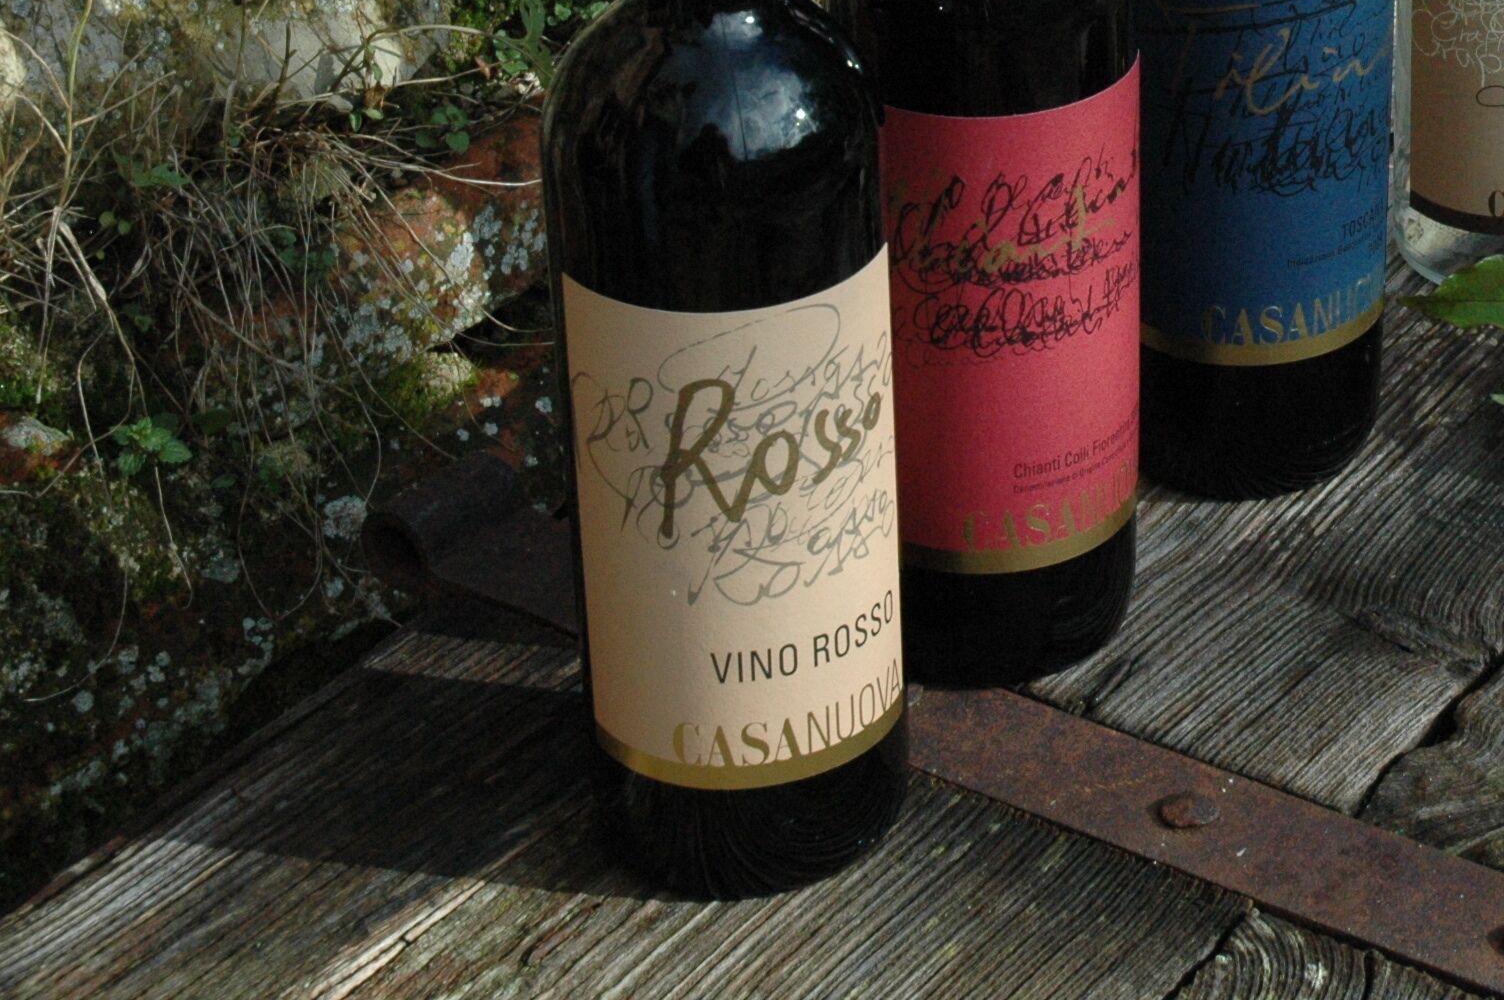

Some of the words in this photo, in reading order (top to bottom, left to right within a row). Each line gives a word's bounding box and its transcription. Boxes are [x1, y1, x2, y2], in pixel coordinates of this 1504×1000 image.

[661, 377, 882, 540] Rosso
[1013, 454, 1062, 480] Chianti
[1064, 443, 1090, 468] Colli
[710, 643, 799, 685] VINO
[812, 589, 894, 669] ROSSO
[672, 657, 901, 767] CASANUOVA
